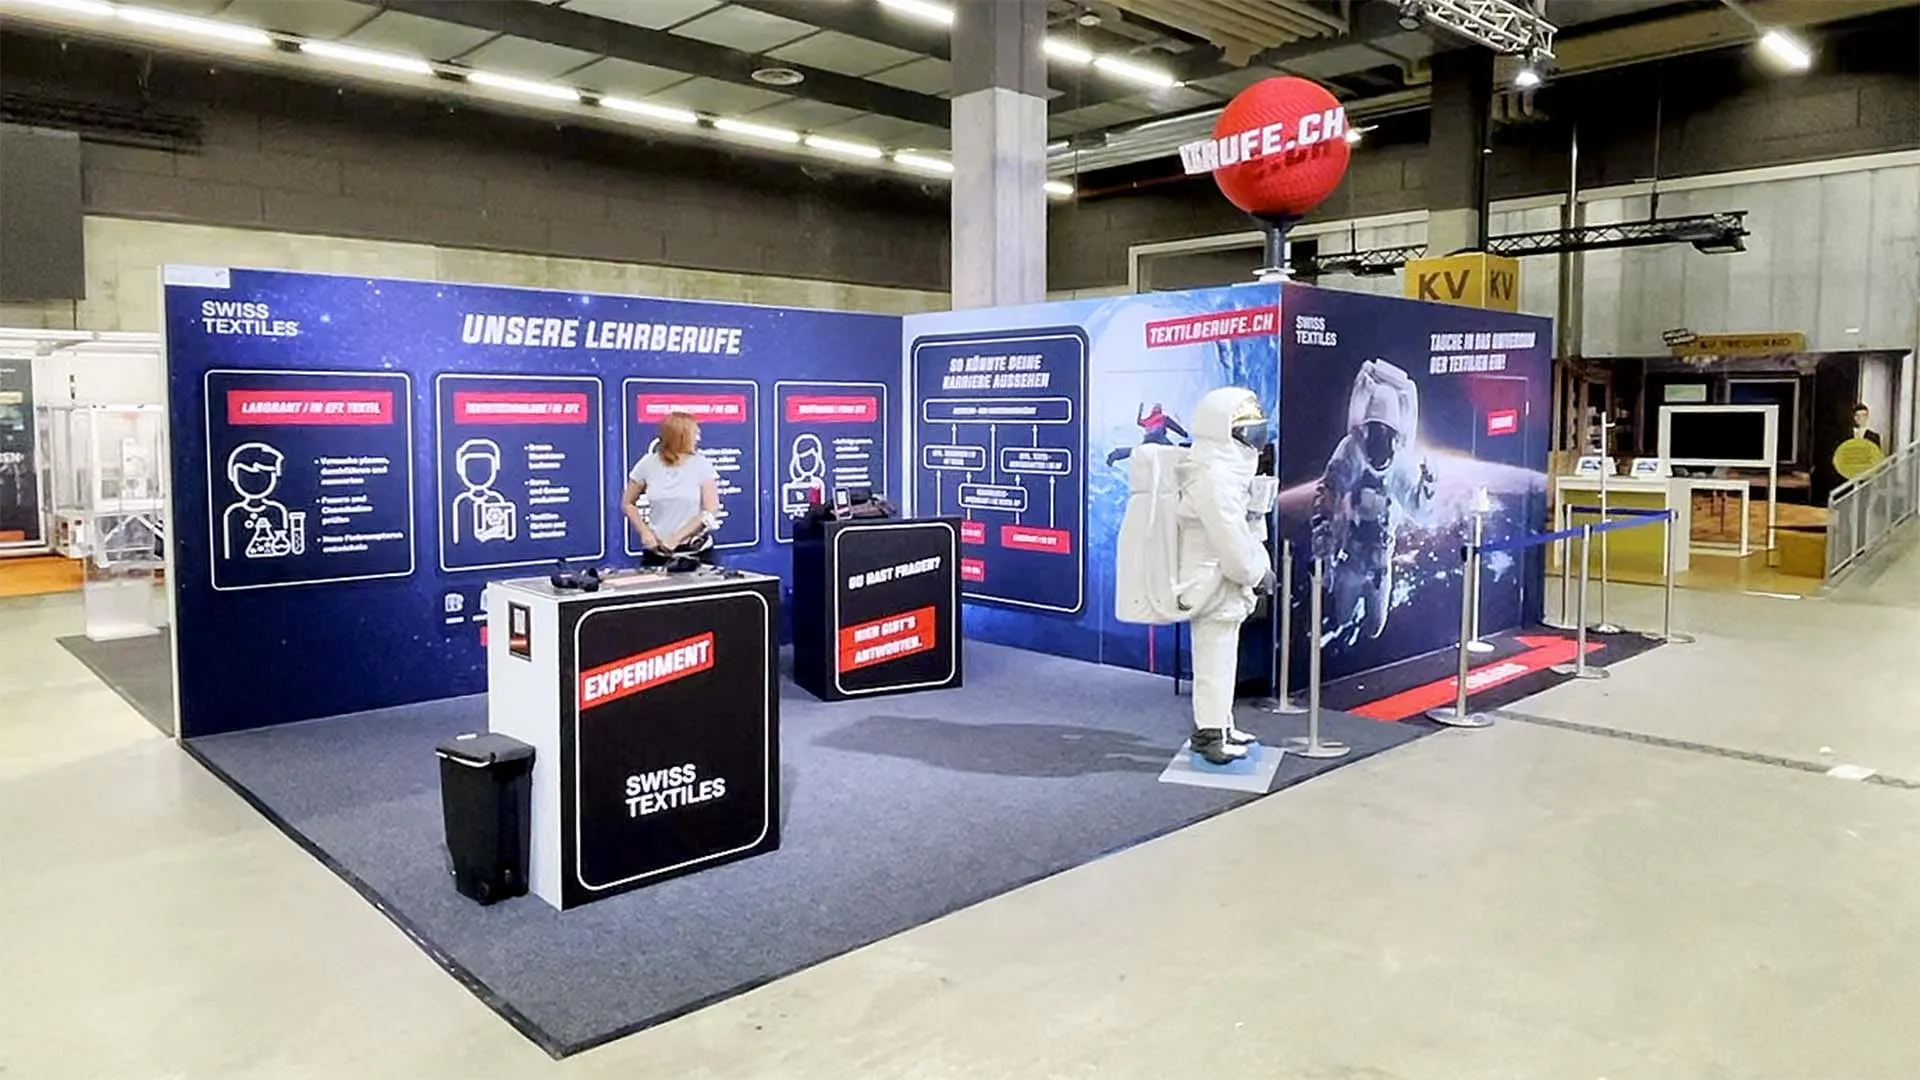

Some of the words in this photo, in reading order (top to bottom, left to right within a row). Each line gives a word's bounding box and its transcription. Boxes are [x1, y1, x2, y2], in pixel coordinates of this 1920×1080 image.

[1419, 269, 1470, 300] KV
[1490, 268, 1514, 300] KV
[202, 301, 269, 318] SWISS
[202, 318, 299, 336] TEXTILES
[462, 314, 579, 348] UNSERE
[585, 320, 743, 355] LEHRBERUFE
[1150, 313, 1274, 344] TEXTILBERUFE.CH
[1296, 315, 1326, 331] SWISS
[1296, 330, 1338, 346] TEXTILES
[949, 358, 964, 372] SO
[943, 375, 992, 389] KARRIERE
[993, 372, 1050, 388] AUSSEHEN
[866, 567, 894, 585] HAST
[584, 640, 711, 701] EXPERIMENT
[625, 764, 696, 796] SWISS
[625, 778, 726, 818] TEXTILES
